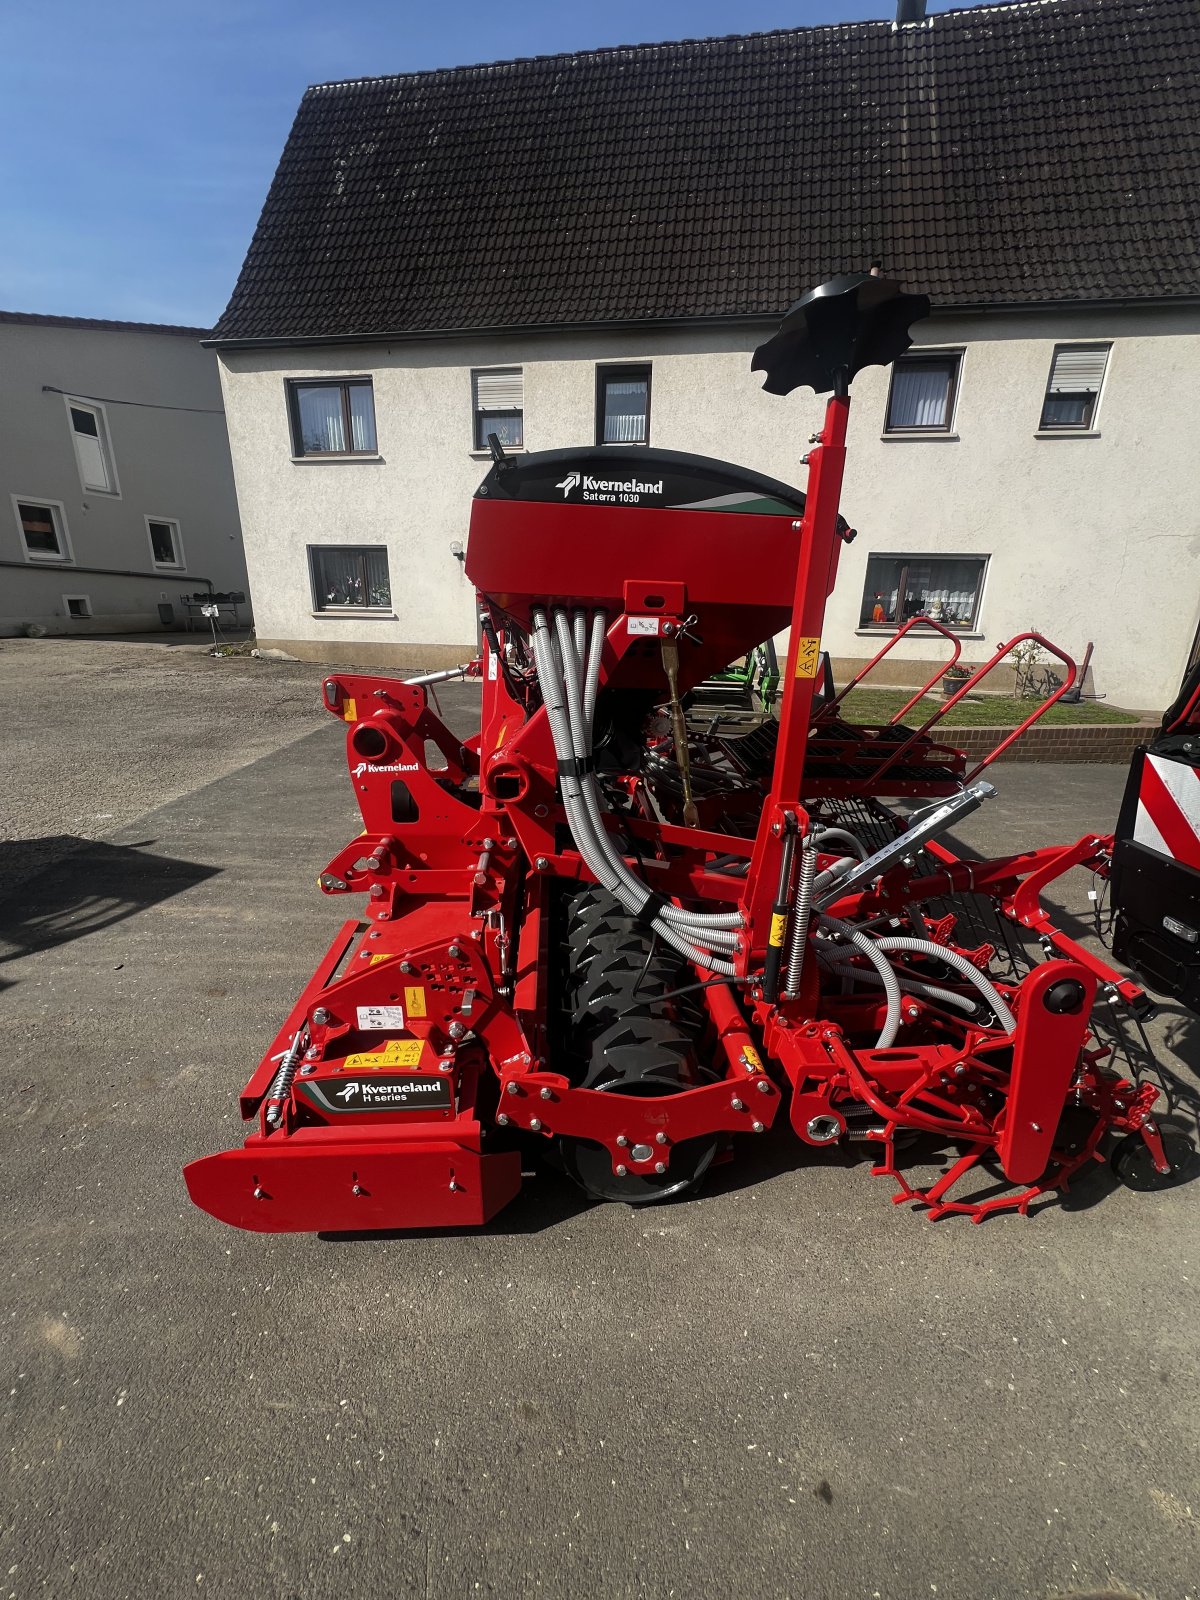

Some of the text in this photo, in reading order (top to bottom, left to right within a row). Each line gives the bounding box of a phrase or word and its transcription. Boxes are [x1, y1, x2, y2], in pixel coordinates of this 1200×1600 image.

[583, 476, 663, 493] Kverneland
[583, 491, 640, 503] Saterra 1030
[368, 763, 418, 772] Kverneland
[362, 1082, 440, 1094] Kverneland
[363, 1094, 407, 1102] H series
